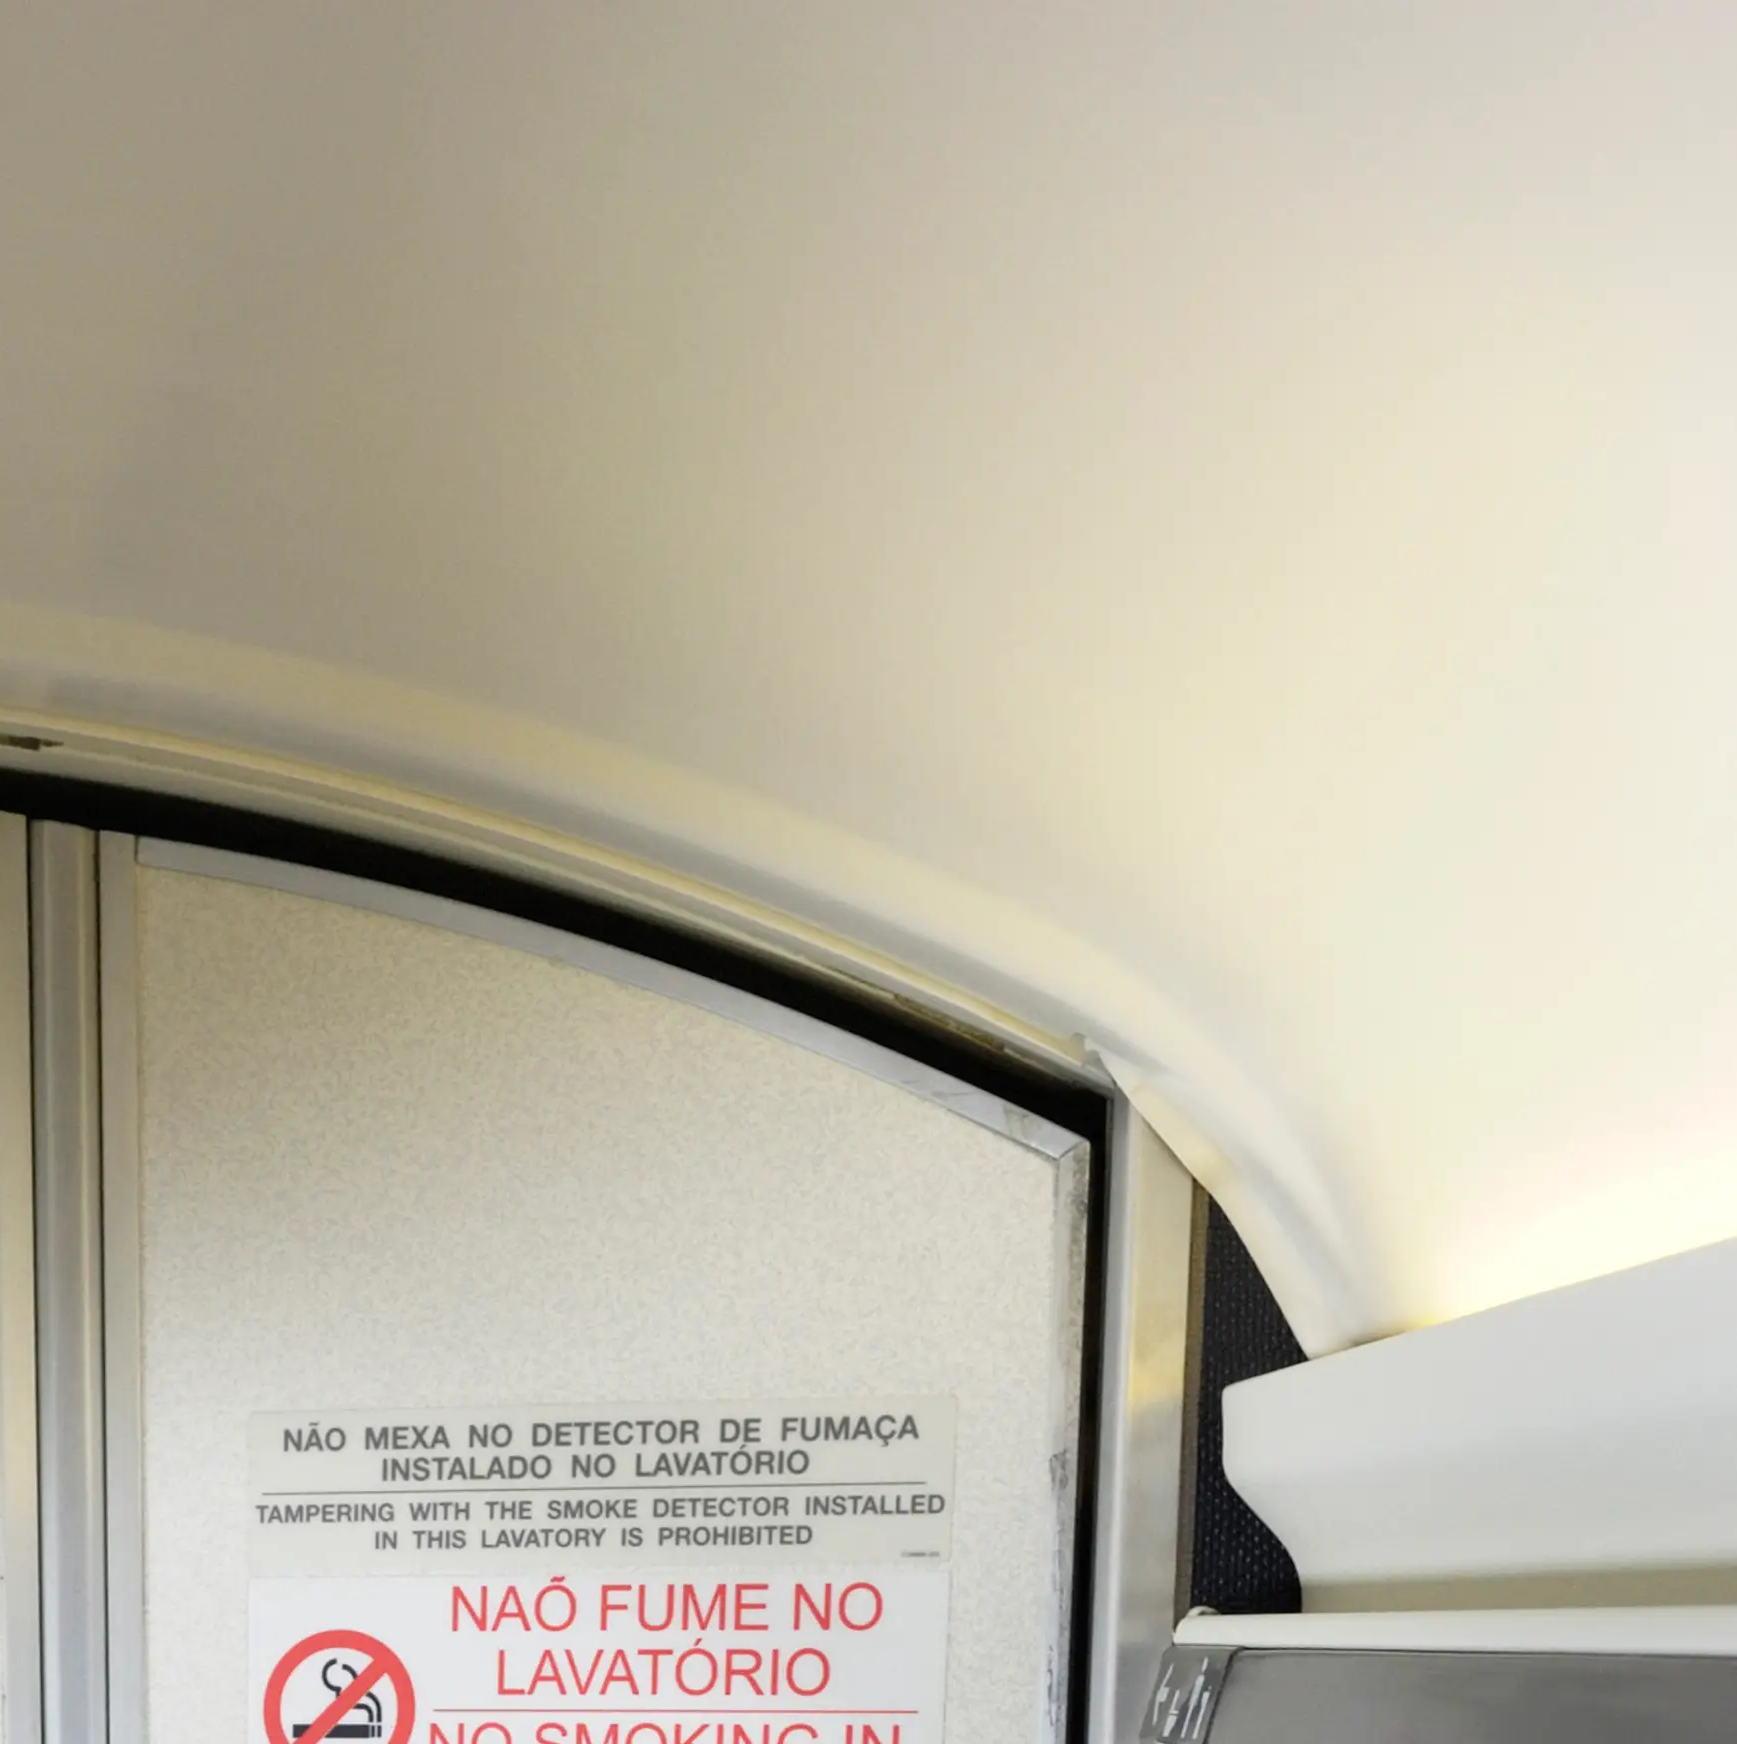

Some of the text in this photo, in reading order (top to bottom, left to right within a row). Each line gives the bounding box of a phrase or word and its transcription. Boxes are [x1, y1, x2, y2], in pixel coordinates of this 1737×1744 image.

[283, 1415, 919, 1452] NÃO MEXA NO DETECTOR DE FUMAÇA
[381, 1445, 810, 1482] INSTALADO NO LAVATÓRIO
[255, 1494, 945, 1524] TAMPERING WITH THE SMOKE DETECTOR INSTALLED
[374, 1524, 813, 1550] IN THIS LAVATORY IS PROHIBITED
[451, 1578, 883, 1632] NAÕ FUME NO
[497, 1640, 831, 1696] LAVATÓRIO
